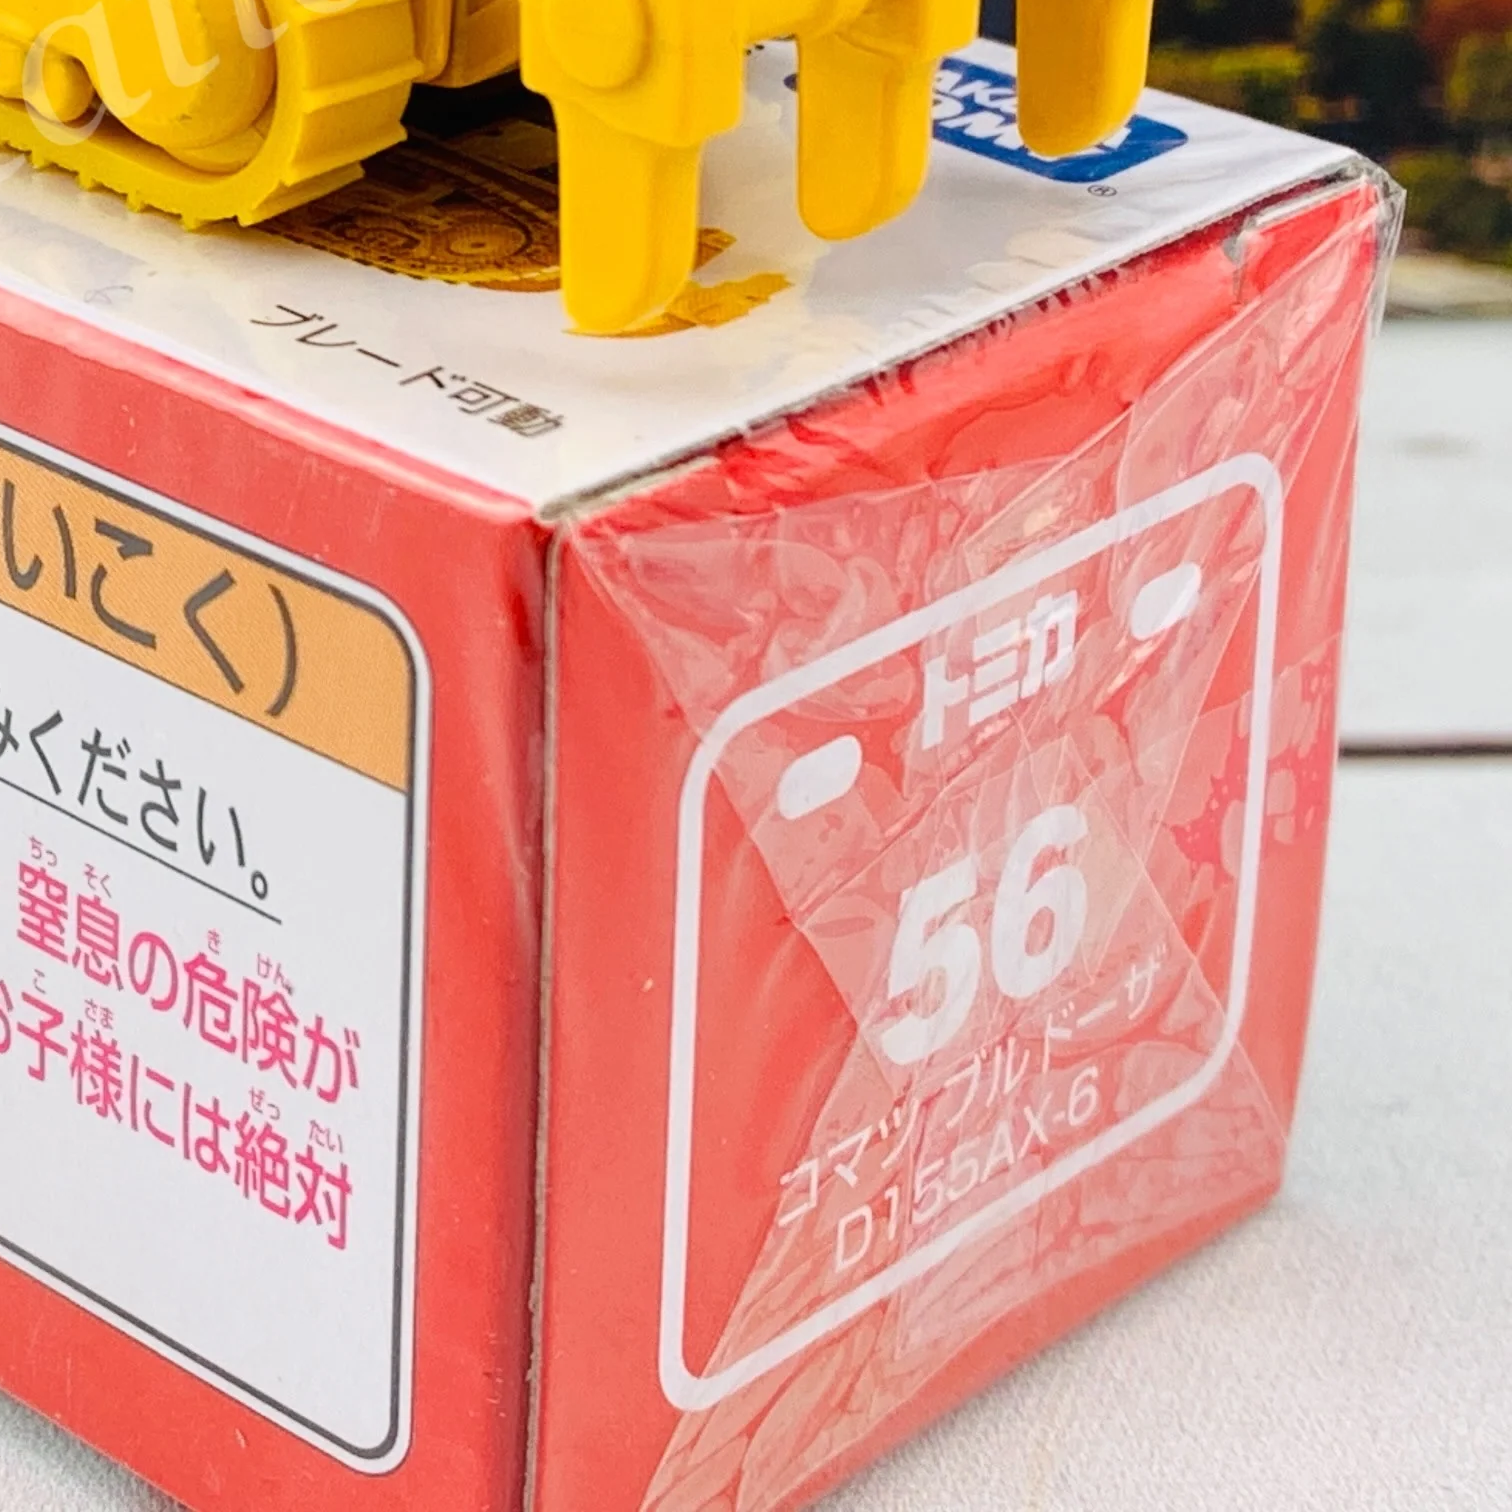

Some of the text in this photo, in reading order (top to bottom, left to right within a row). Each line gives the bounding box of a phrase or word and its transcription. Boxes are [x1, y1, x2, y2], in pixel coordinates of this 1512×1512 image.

[250, 304, 565, 438] ブレード可動
[921, 589, 1079, 751] トミカ
[880, 804, 1089, 1067] 56
[778, 942, 1167, 1228] コマツ ブルドーザ
[834, 1065, 1100, 1273] D155AX-6
